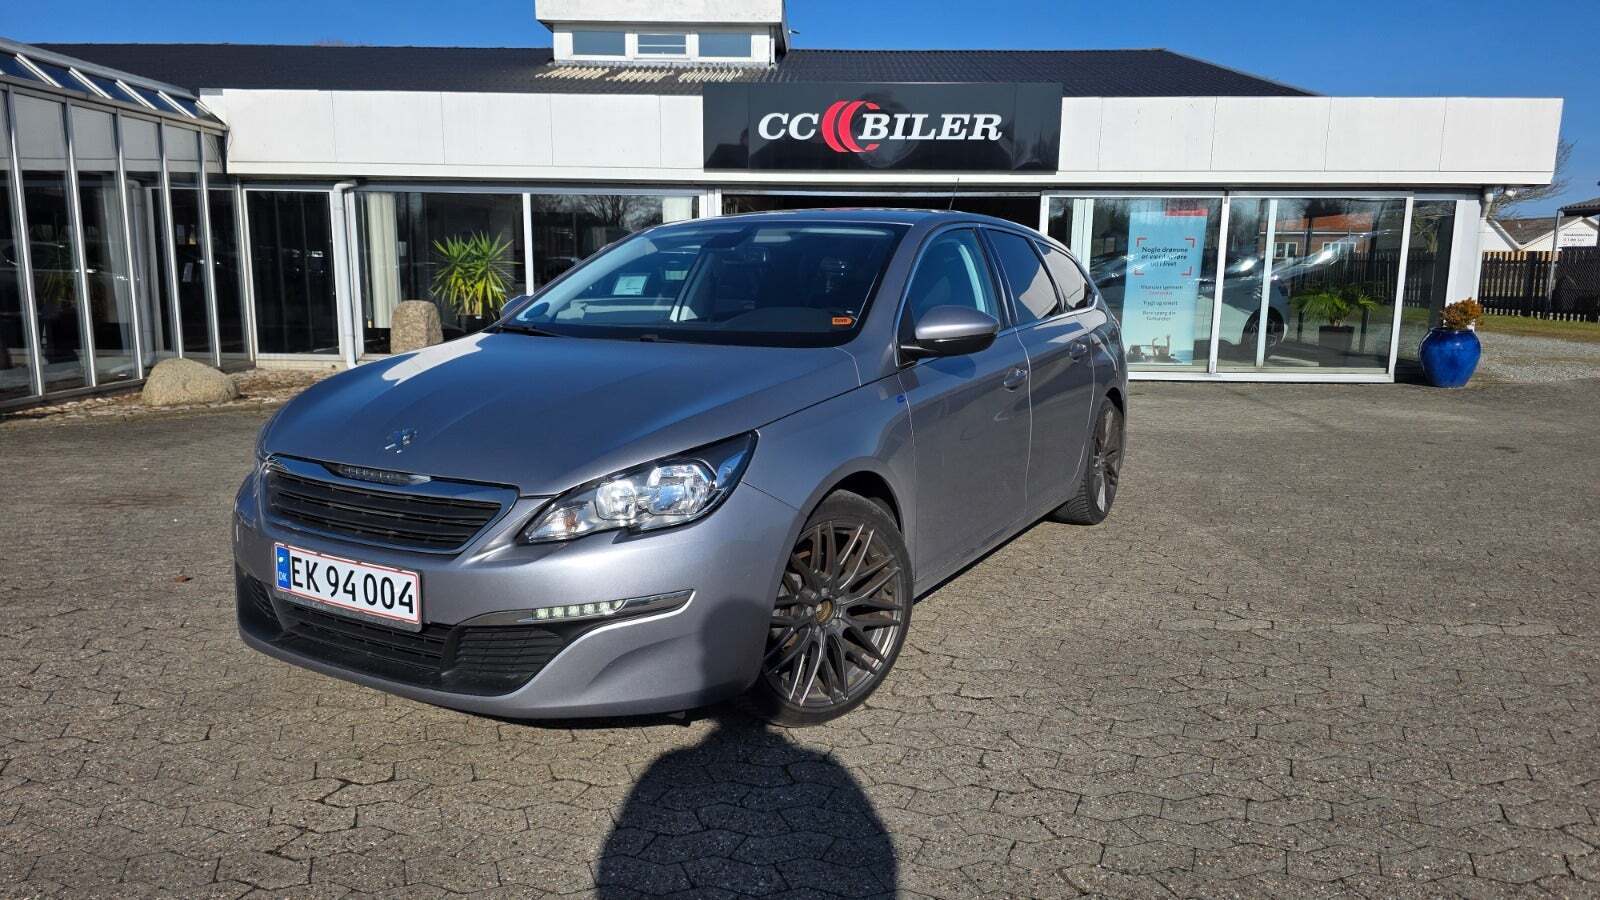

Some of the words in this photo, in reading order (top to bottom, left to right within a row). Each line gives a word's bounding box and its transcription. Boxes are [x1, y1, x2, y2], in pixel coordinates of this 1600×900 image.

[758, 113, 819, 140] CC
[858, 113, 1002, 141] BILER
[1141, 246, 1161, 255] Nogle
[1162, 246, 1188, 254] drømme
[279, 570, 288, 583] DK
[291, 556, 320, 593] EK
[326, 565, 356, 602] 94
[363, 573, 414, 614] 004
